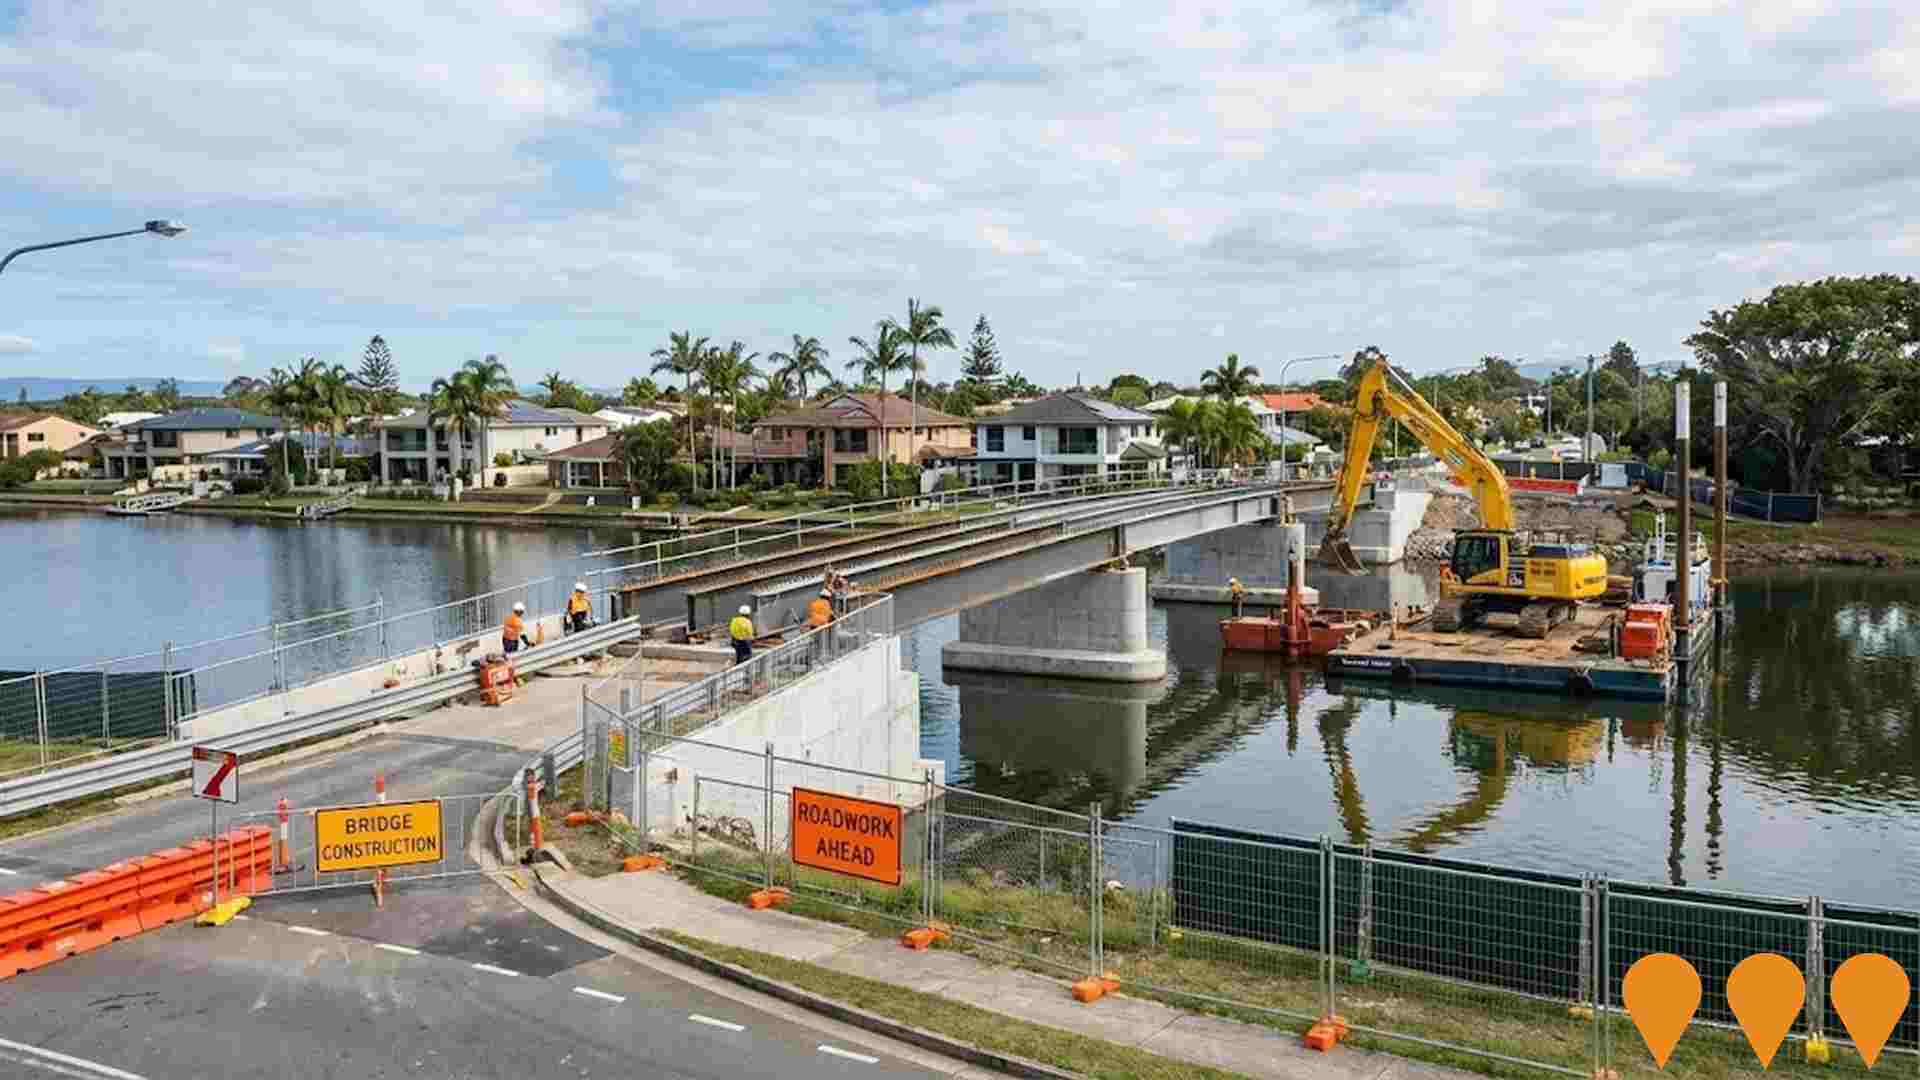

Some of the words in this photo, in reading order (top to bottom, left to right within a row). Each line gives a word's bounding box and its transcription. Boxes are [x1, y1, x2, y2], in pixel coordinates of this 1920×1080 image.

[345, 813, 413, 834] BRIDGE
[321, 836, 436, 860] CONSTRUCTION
[817, 837, 874, 866] AHEAD
